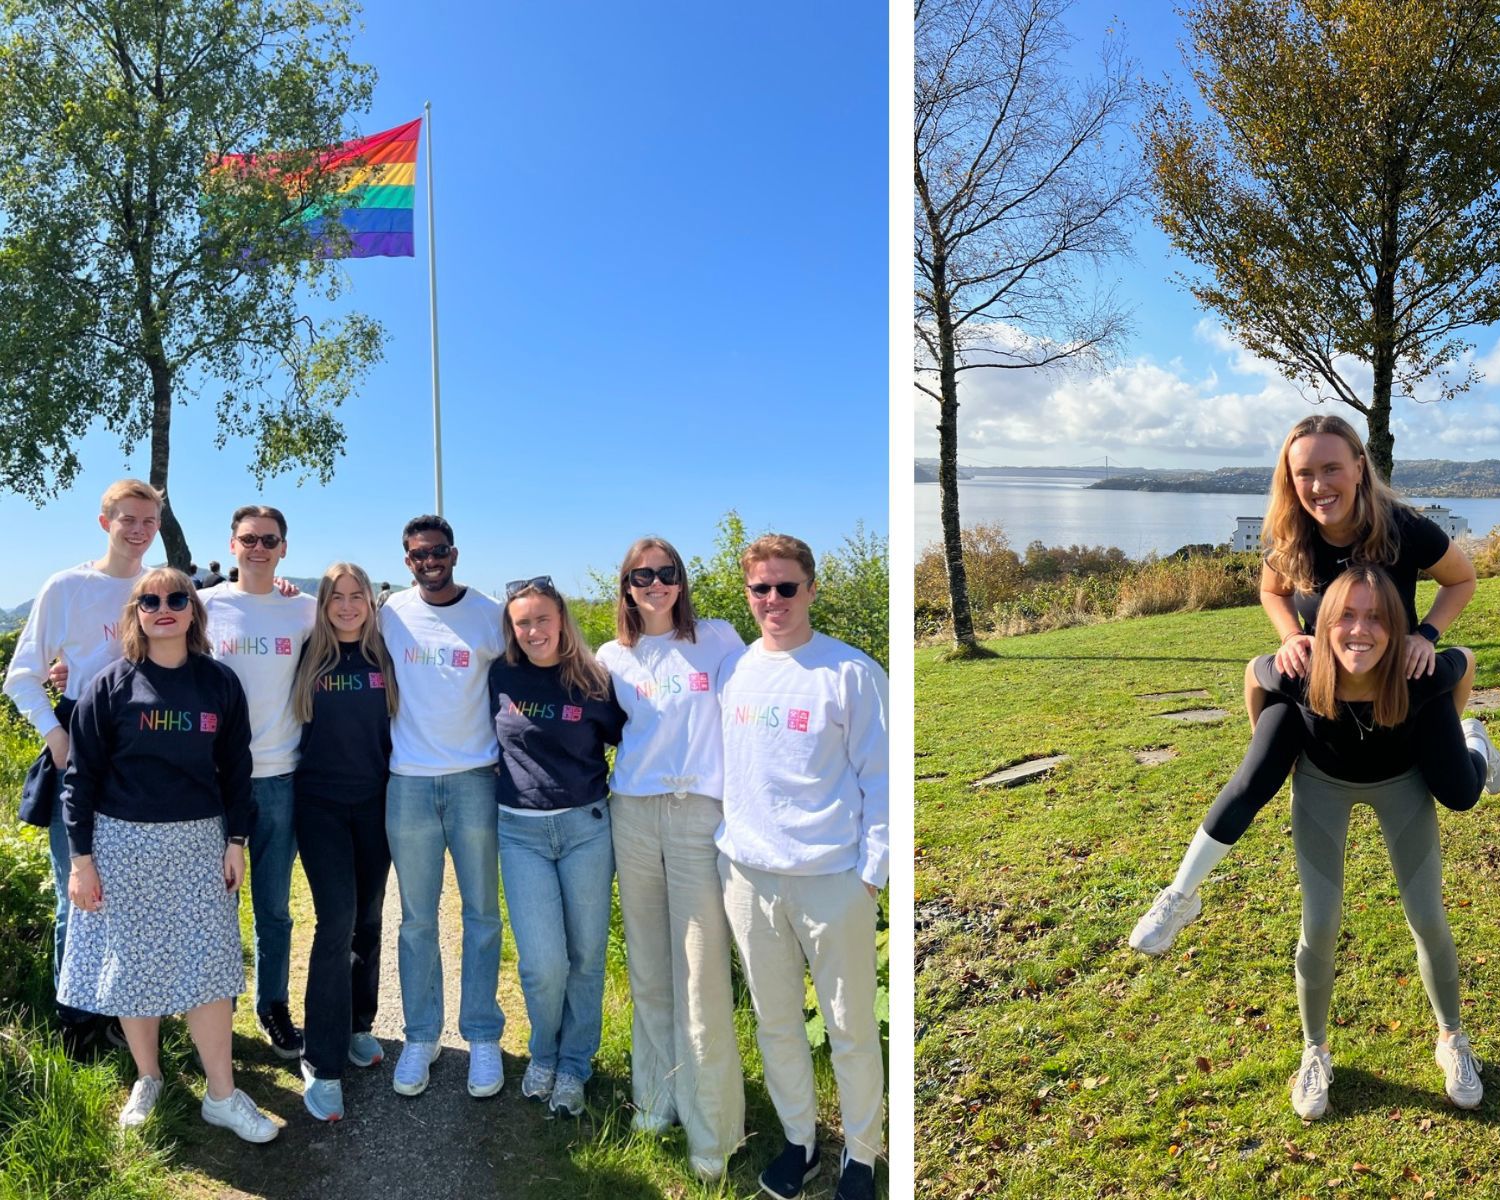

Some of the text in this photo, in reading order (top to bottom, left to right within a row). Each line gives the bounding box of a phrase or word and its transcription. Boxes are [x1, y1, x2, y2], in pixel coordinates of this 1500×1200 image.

[221, 636, 269, 657] NHHS
[404, 648, 446, 666] NHHS
[315, 673, 363, 692] NHHS
[508, 701, 556, 719] NHHS
[735, 705, 780, 728] NHHS
[139, 709, 193, 732] NHHS
